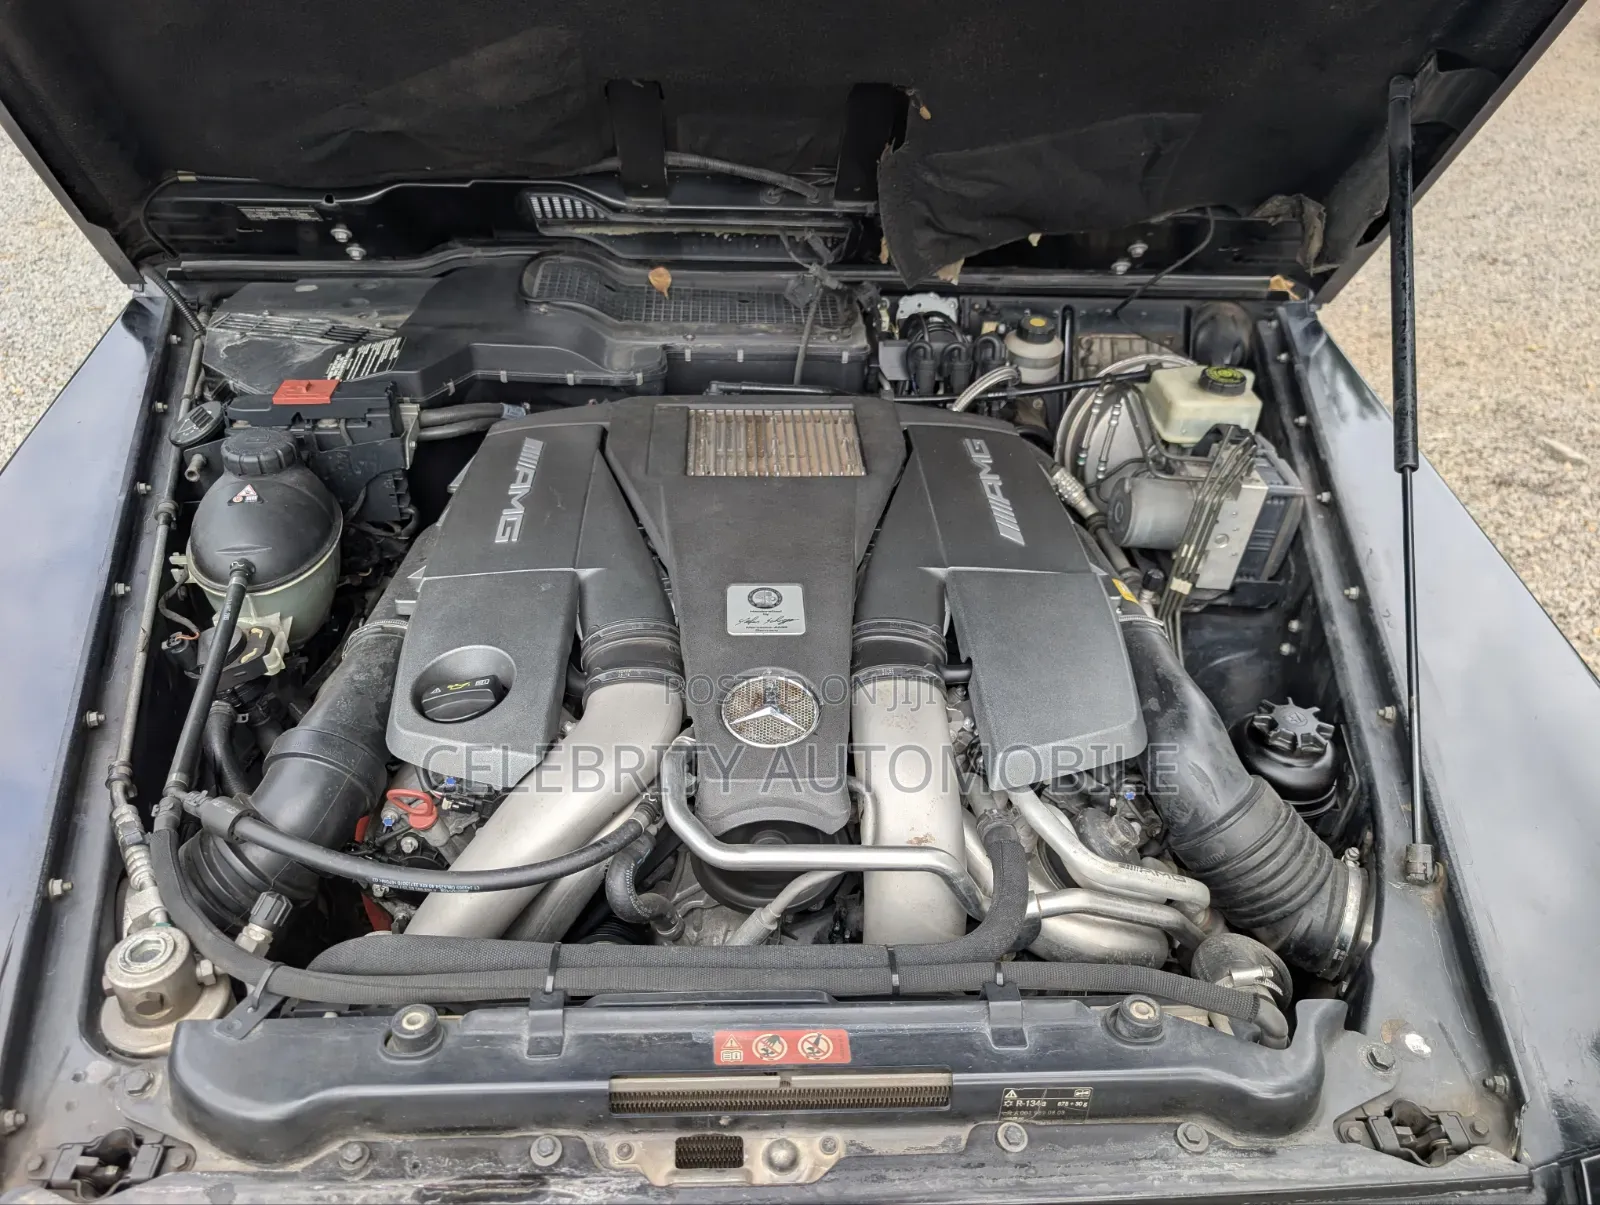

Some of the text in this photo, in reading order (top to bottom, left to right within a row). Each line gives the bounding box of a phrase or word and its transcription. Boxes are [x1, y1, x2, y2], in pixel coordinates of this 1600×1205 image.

[495, 460, 538, 543] AMG
[963, 438, 1013, 512] AMG
[1016, 1099, 1047, 1107] R-134a
